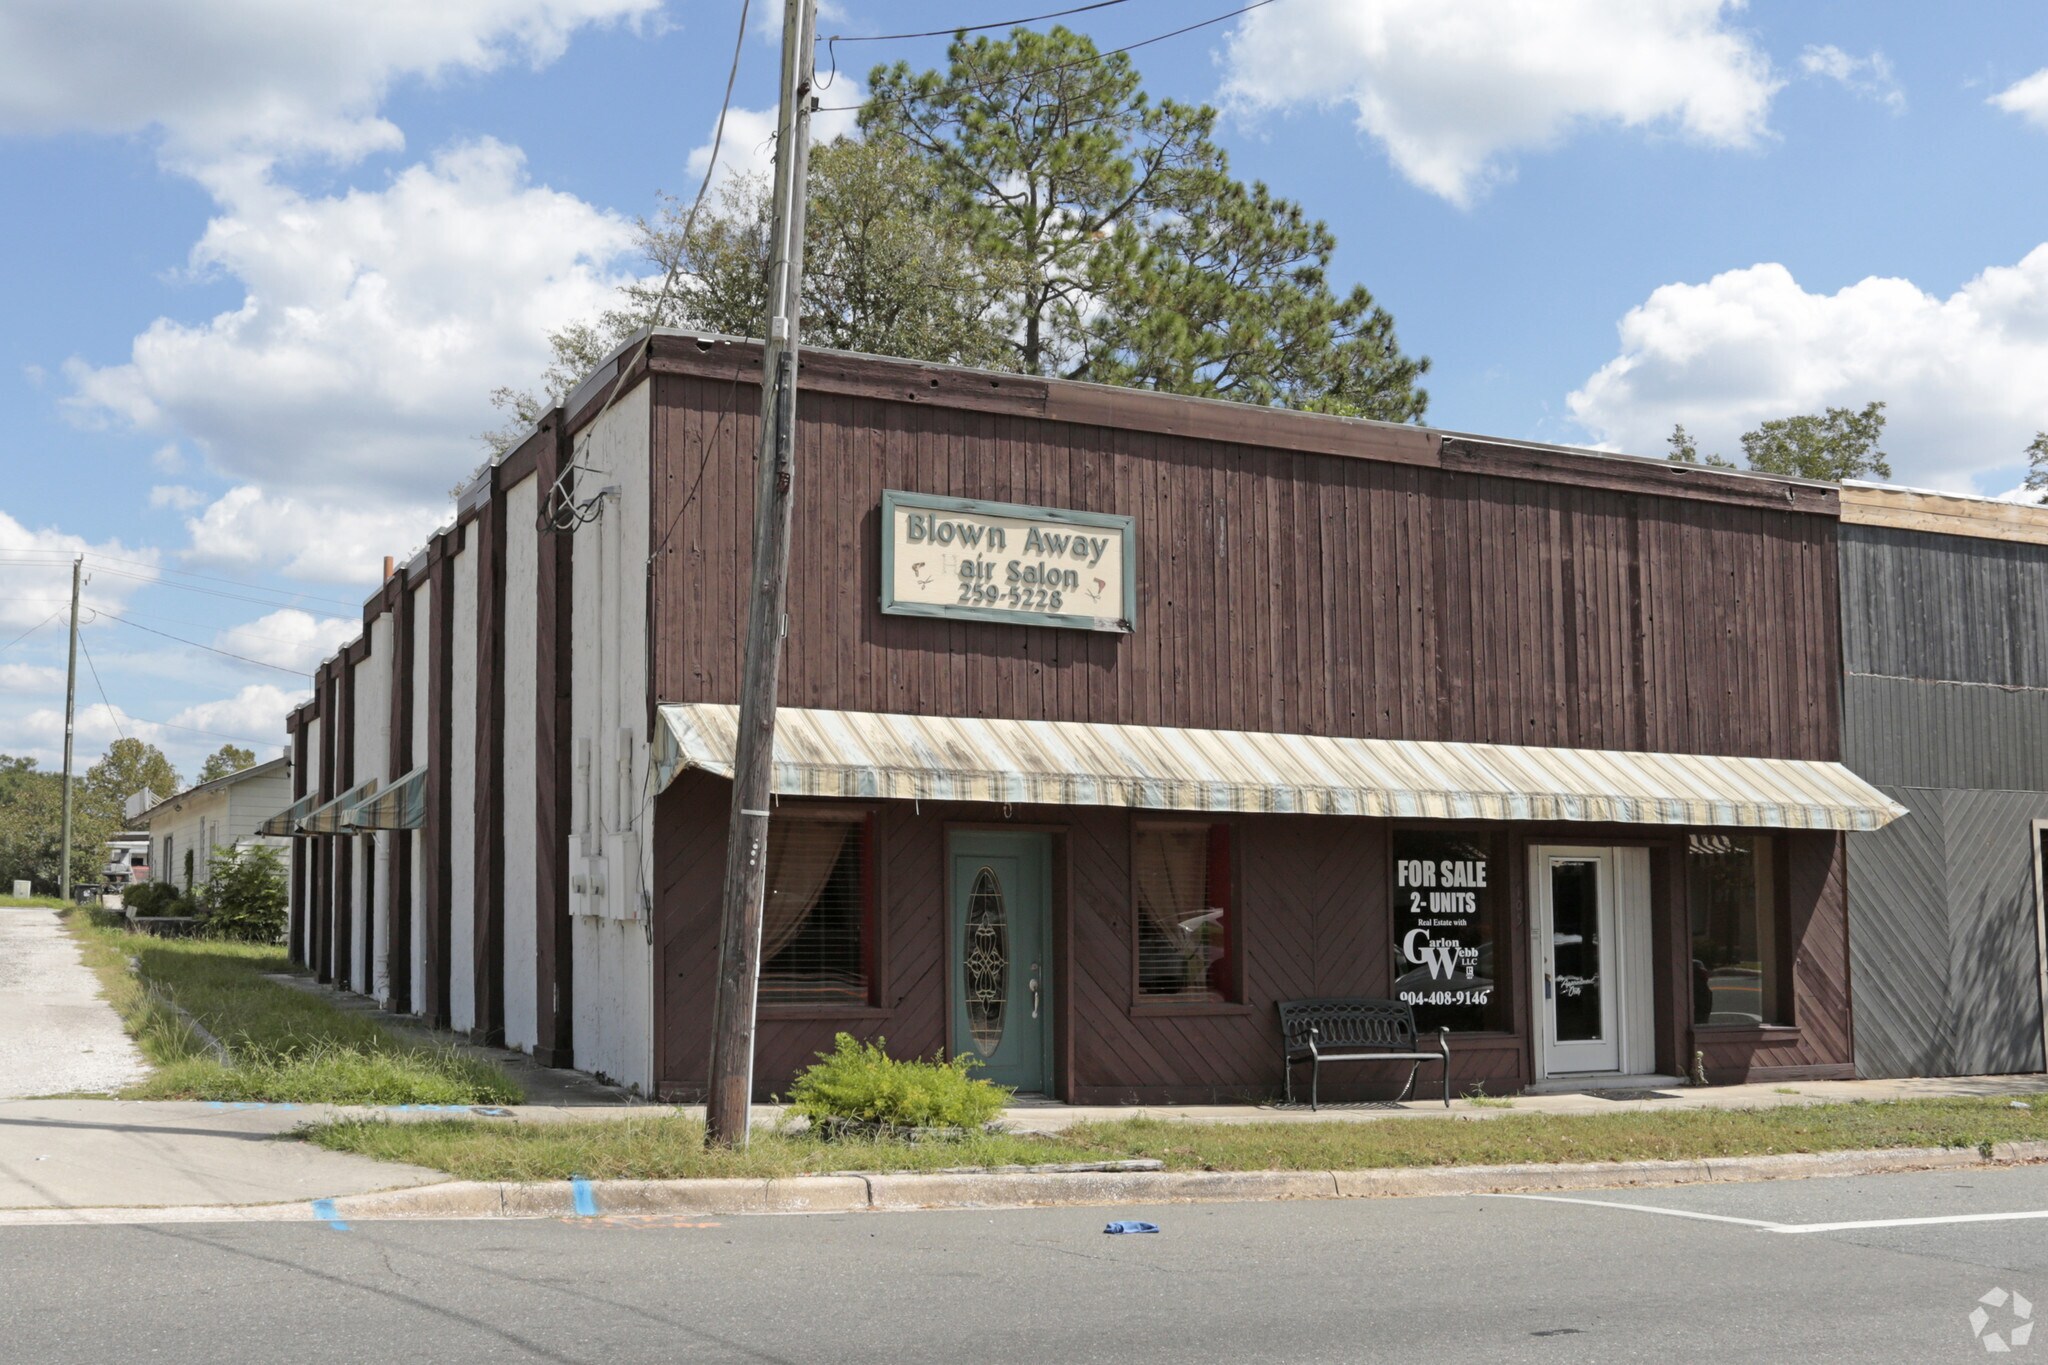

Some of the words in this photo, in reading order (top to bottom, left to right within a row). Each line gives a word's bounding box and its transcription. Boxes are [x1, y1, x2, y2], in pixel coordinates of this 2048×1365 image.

[908, 512, 1007, 549] Blown
[1024, 525, 1109, 567] Away
[1006, 559, 1079, 589] Salon
[957, 582, 1063, 610] 259-5228
[1398, 860, 1436, 887] FOR
[1440, 860, 1487, 887] SALE
[1430, 892, 1476, 913] UNITS
[1418, 918, 1432, 926] Real
[1433, 918, 1452, 926] Estate
[1453, 918, 1467, 926] with
[1418, 947, 1479, 980] Webb
[1461, 958, 1478, 966] LLC
